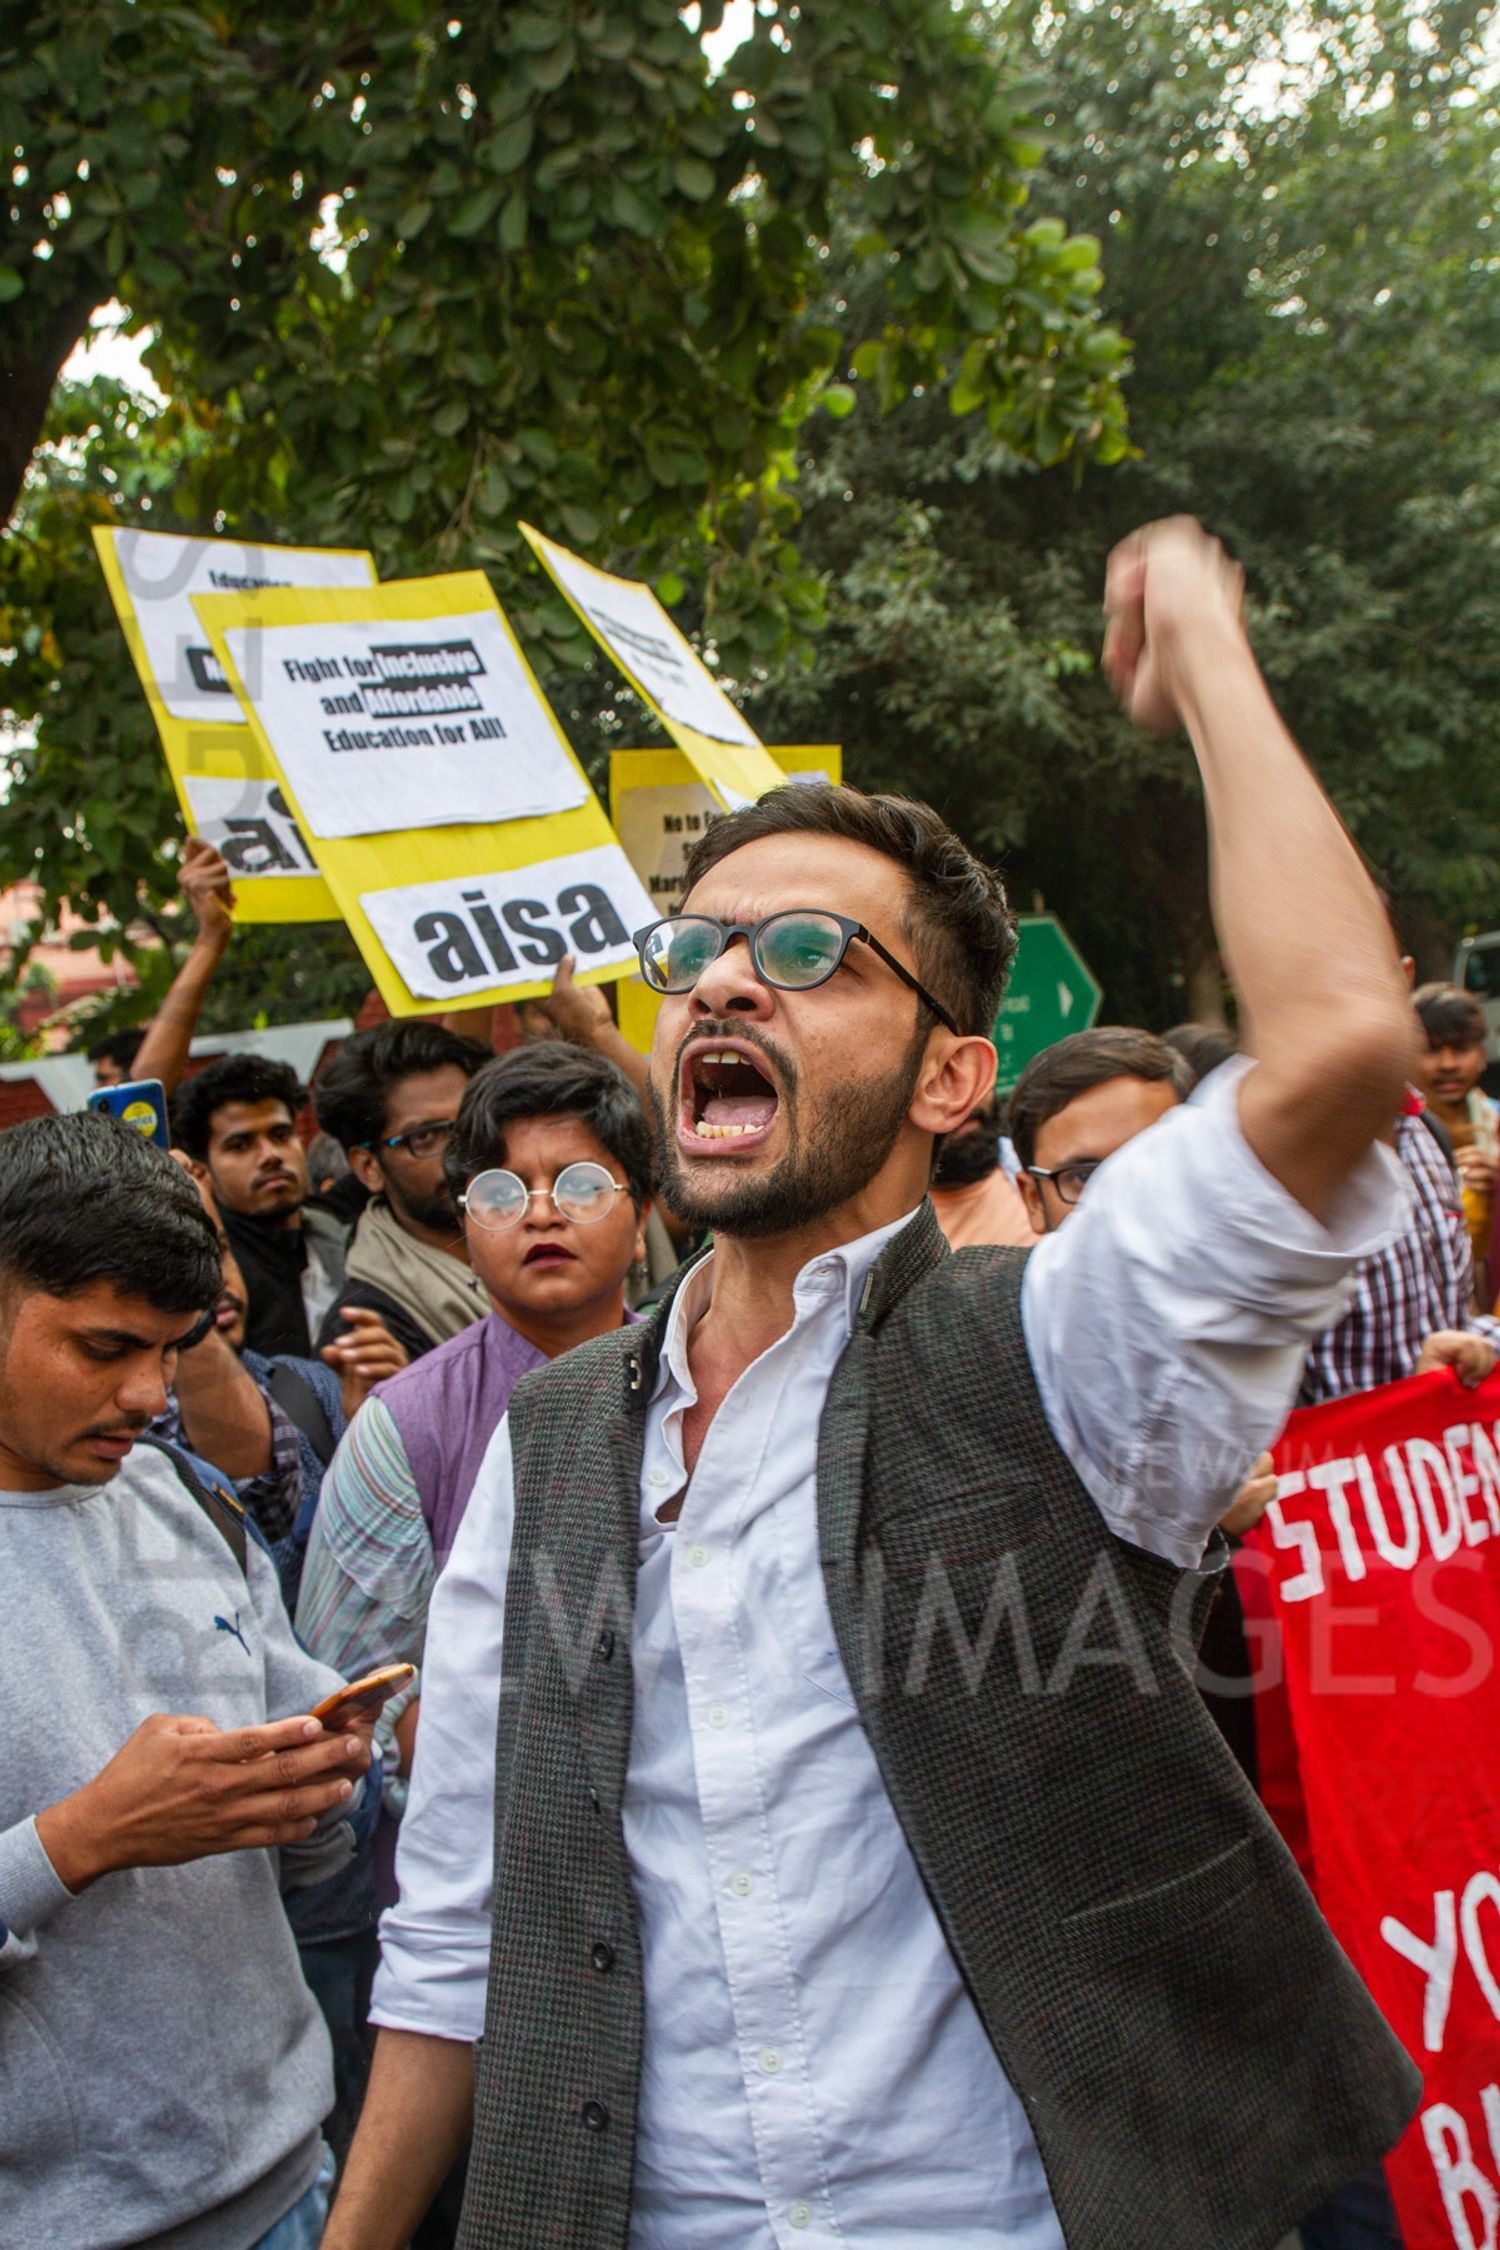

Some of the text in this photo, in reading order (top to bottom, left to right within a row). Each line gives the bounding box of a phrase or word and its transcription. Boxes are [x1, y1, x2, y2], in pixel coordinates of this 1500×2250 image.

[282, 649, 481, 684] Fight for Inclusive
[320, 682, 480, 716] and Affordable
[322, 716, 509, 752] Education for All!
[413, 883, 632, 983] aisa
